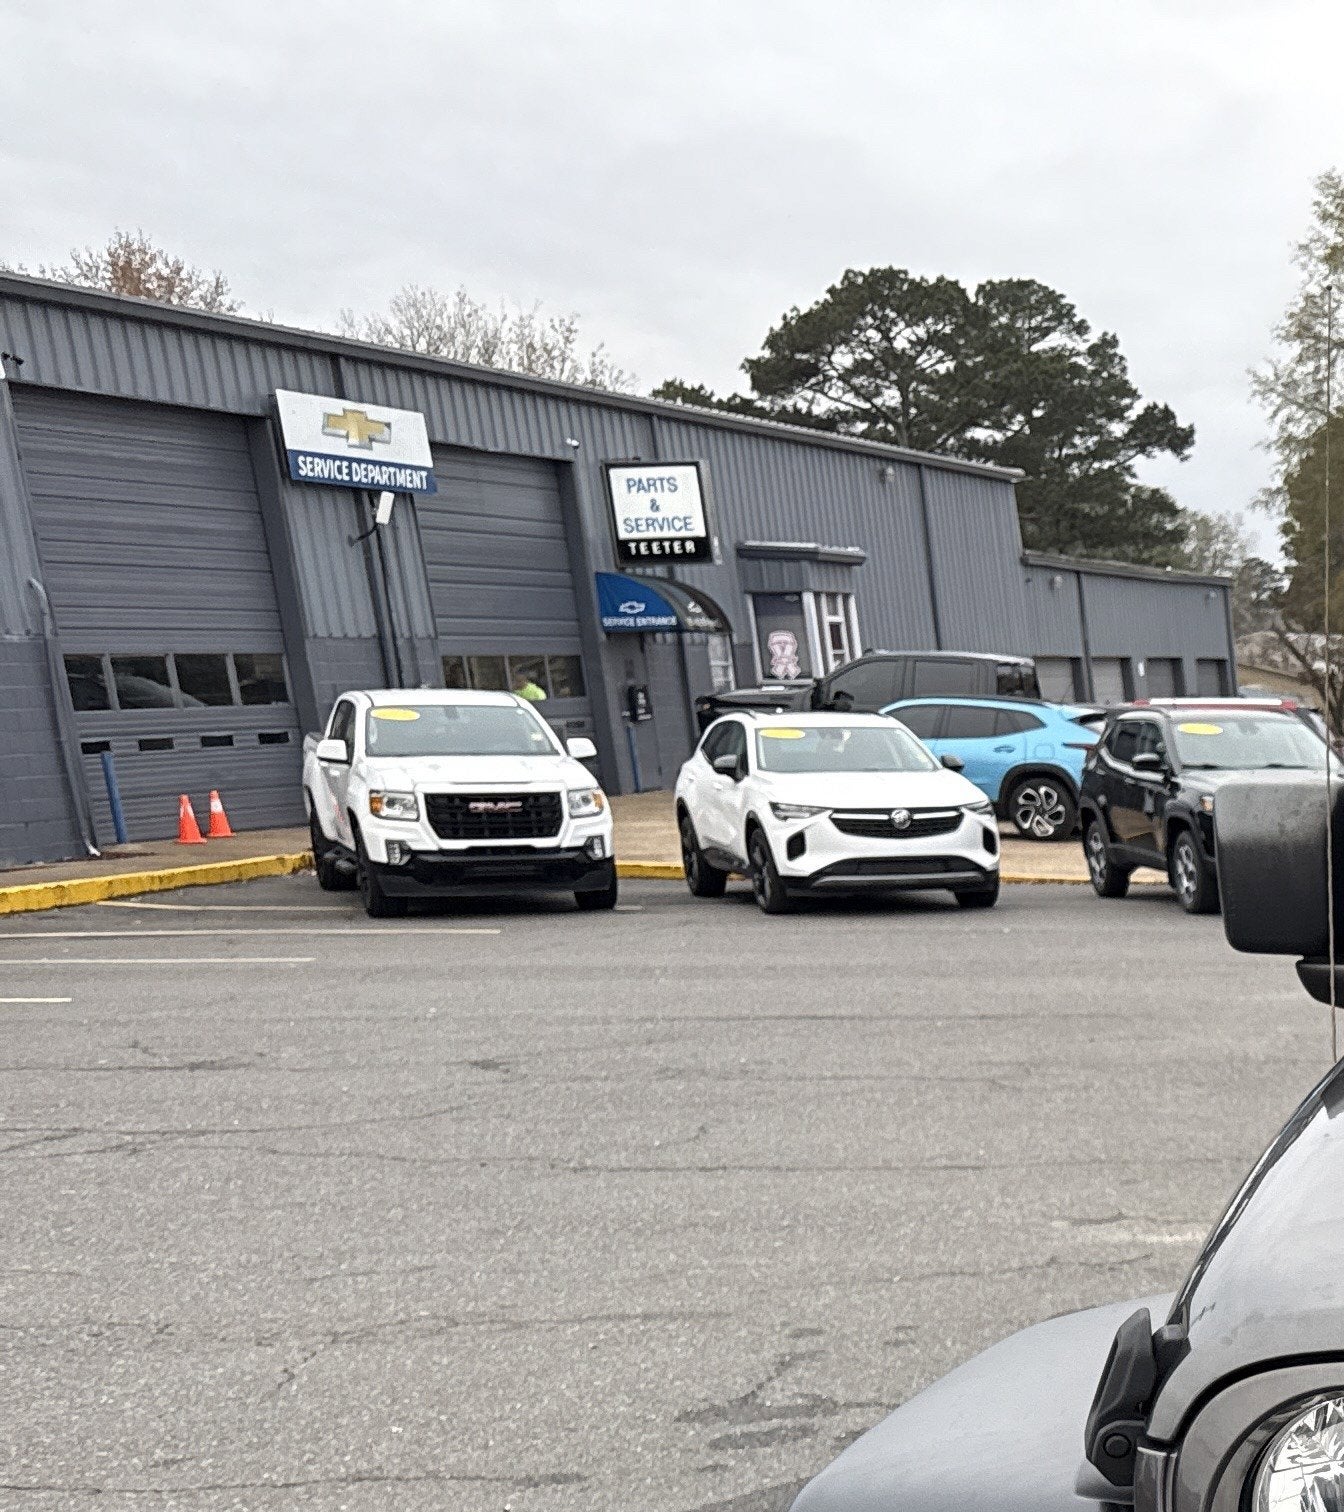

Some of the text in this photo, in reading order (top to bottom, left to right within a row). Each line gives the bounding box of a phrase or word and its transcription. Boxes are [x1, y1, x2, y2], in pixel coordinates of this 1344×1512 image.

[298, 455, 428, 490] SERVICE DEPARTMENT
[626, 476, 679, 494] PARTS
[649, 498, 661, 513] &
[623, 516, 696, 534] SERVICE
[628, 540, 696, 556] TEETER
